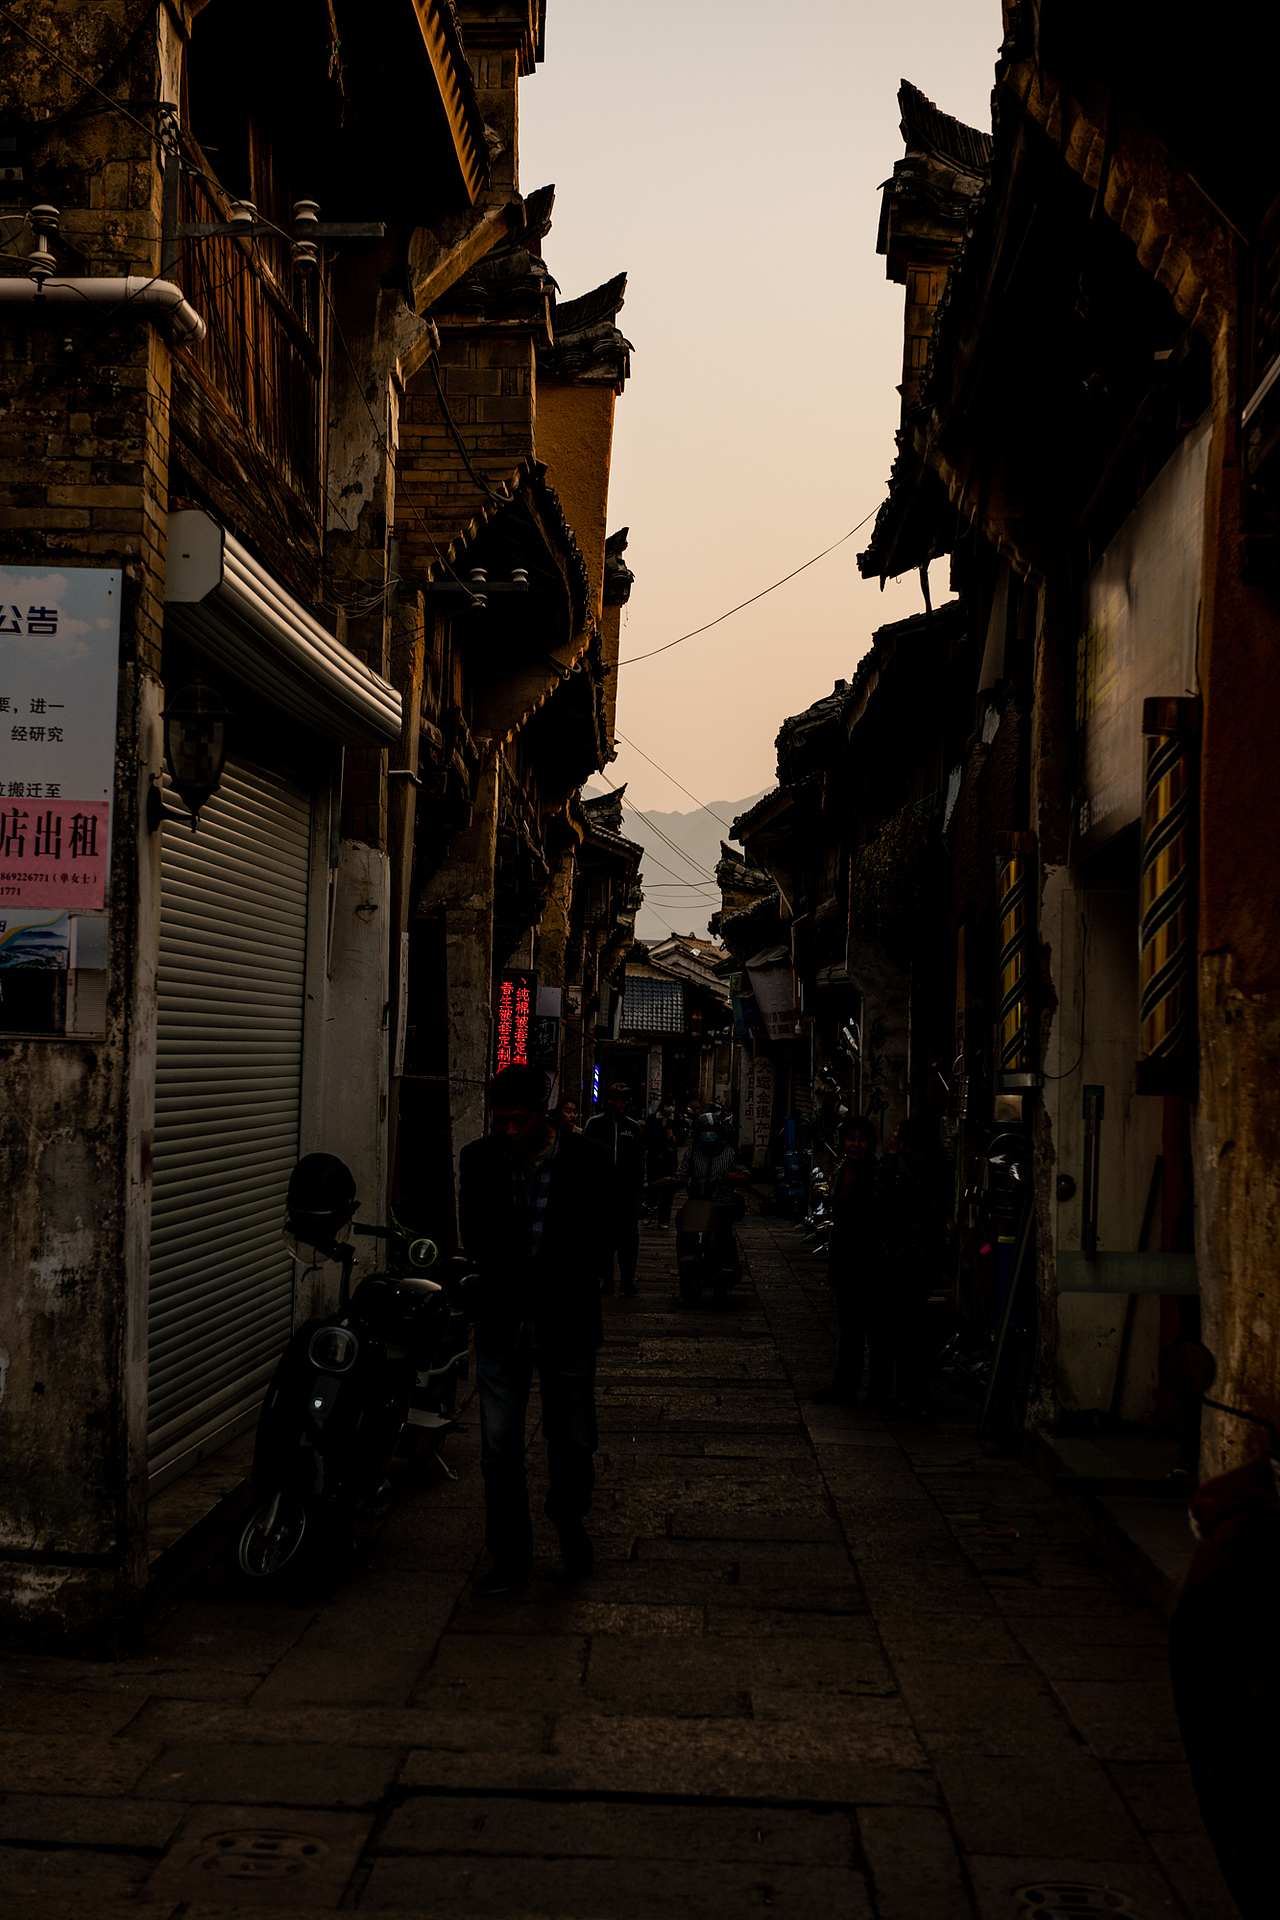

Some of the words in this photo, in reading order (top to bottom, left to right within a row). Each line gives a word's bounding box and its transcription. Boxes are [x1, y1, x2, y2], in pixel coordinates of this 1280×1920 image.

[0, 605, 58, 634] 公告
[11, 726, 64, 742] 经研究
[0, 806, 99, 860] 店出租
[0, 887, 21, 896] 1771
[755, 1061, 771, 1147] 大运金银加工
